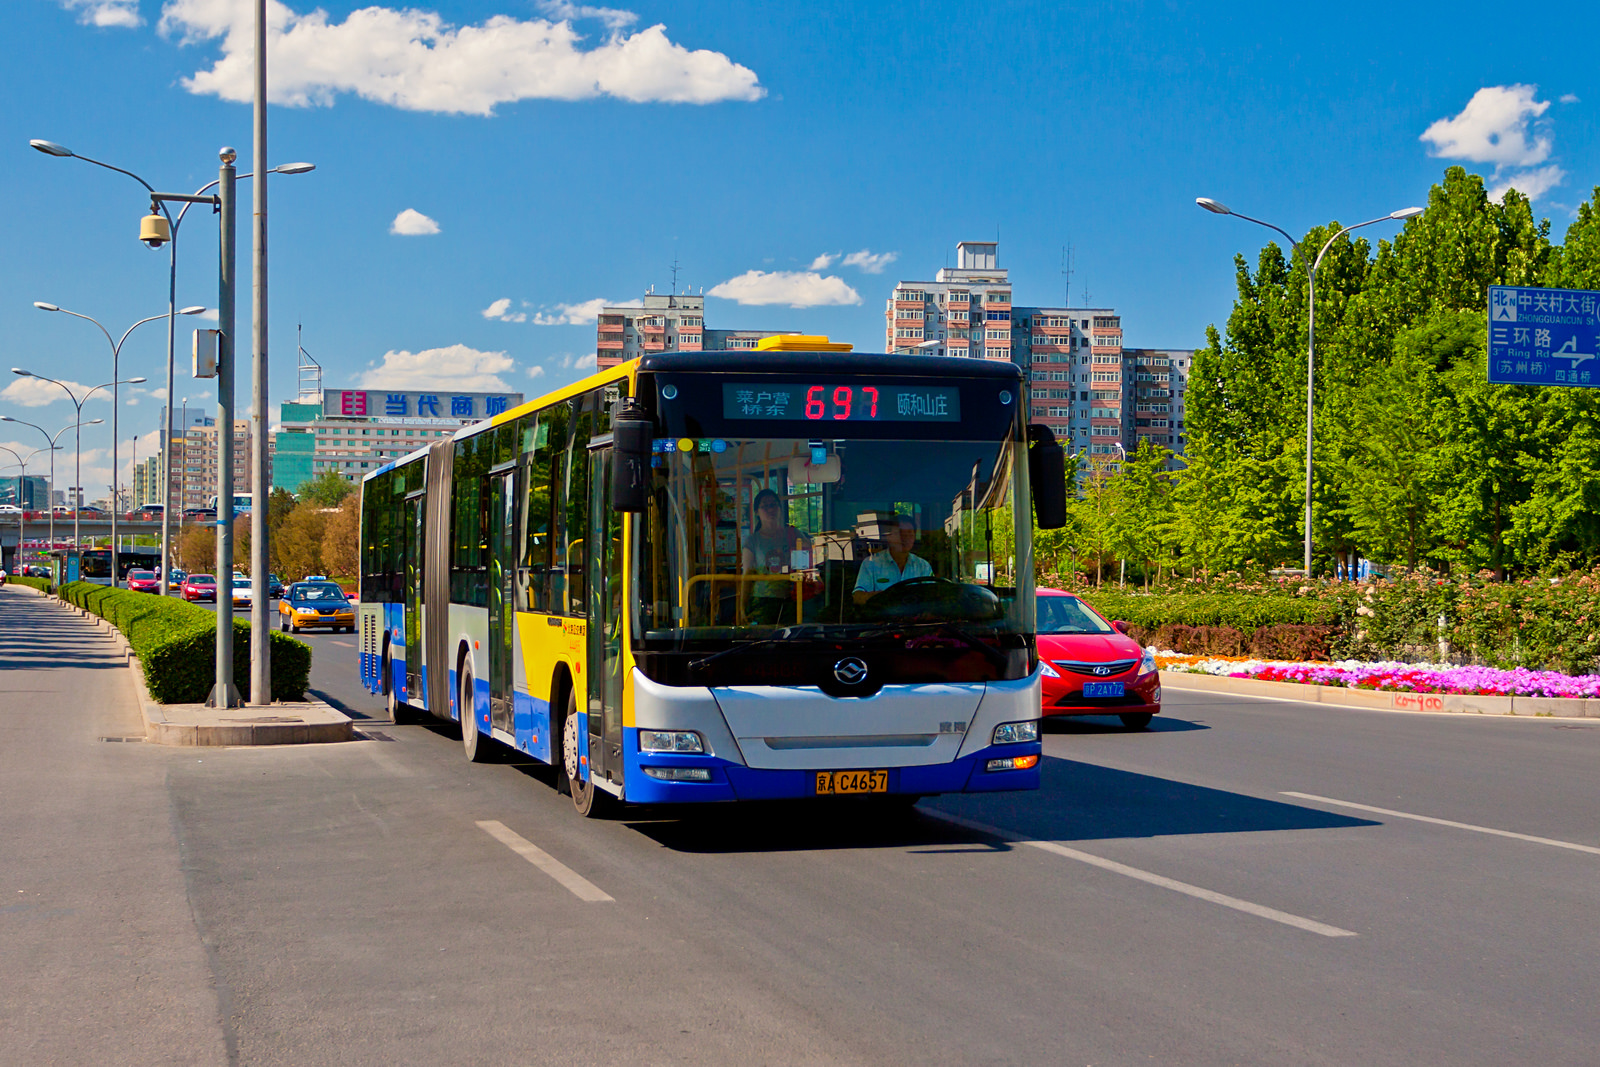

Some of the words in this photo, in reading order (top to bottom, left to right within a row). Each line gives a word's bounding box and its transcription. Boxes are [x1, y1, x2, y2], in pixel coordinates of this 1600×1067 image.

[1494, 291, 1508, 306] 北
[1509, 298, 1516, 307] N
[1518, 291, 1596, 315] 中关村大街
[1518, 313, 1583, 325] ZHONGGUANCUN
[1586, 317, 1594, 326] St
[1492, 327, 1552, 348] 三环路
[1507, 347, 1530, 359] Ring
[1536, 349, 1550, 358] Rd
[1555, 369, 1591, 383] 四通桥
[385, 393, 507, 417] 当代商城
[736, 390, 790, 405] 菜户营
[804, 385, 879, 420] 697
[897, 393, 948, 416] 颐和山庄
[741, 404, 786, 416] 桥东
